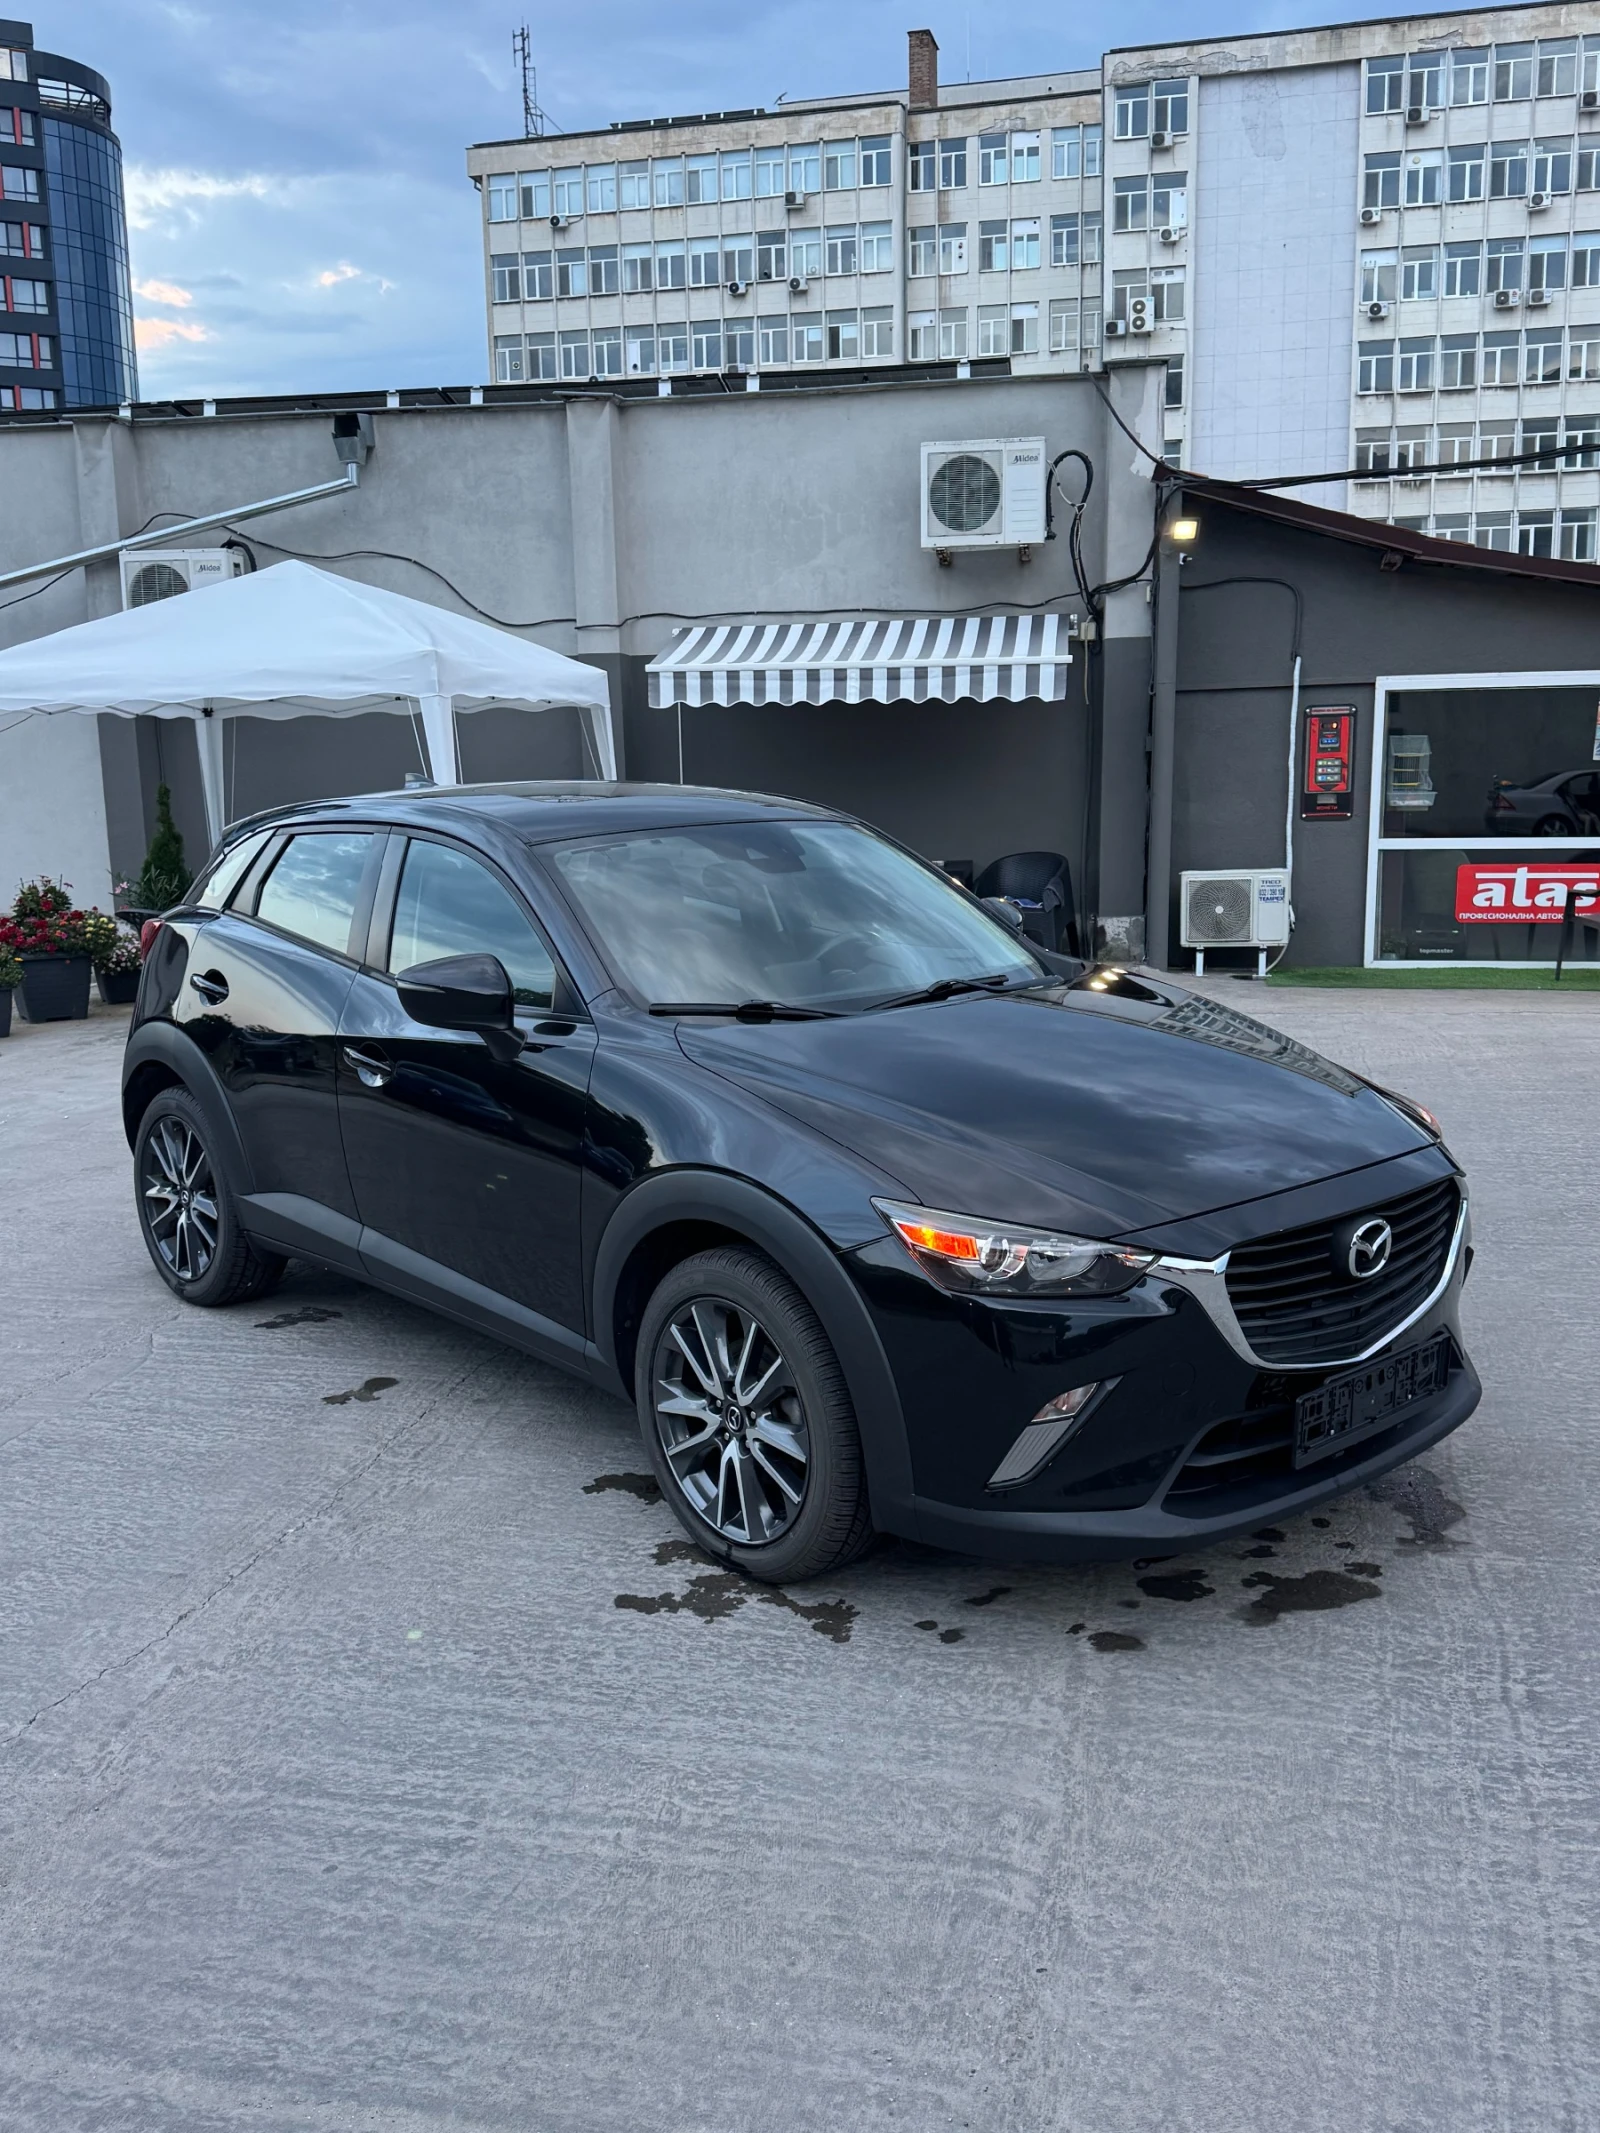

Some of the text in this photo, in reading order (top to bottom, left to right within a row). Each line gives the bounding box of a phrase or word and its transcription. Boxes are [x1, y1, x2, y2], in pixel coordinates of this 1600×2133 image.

[1012, 454, 1039, 464] Midea
[197, 564, 221, 573] Midea
[1472, 866, 1599, 907] atas
[1459, 912, 1535, 920] ПРОФЕСИОНАЛНА
